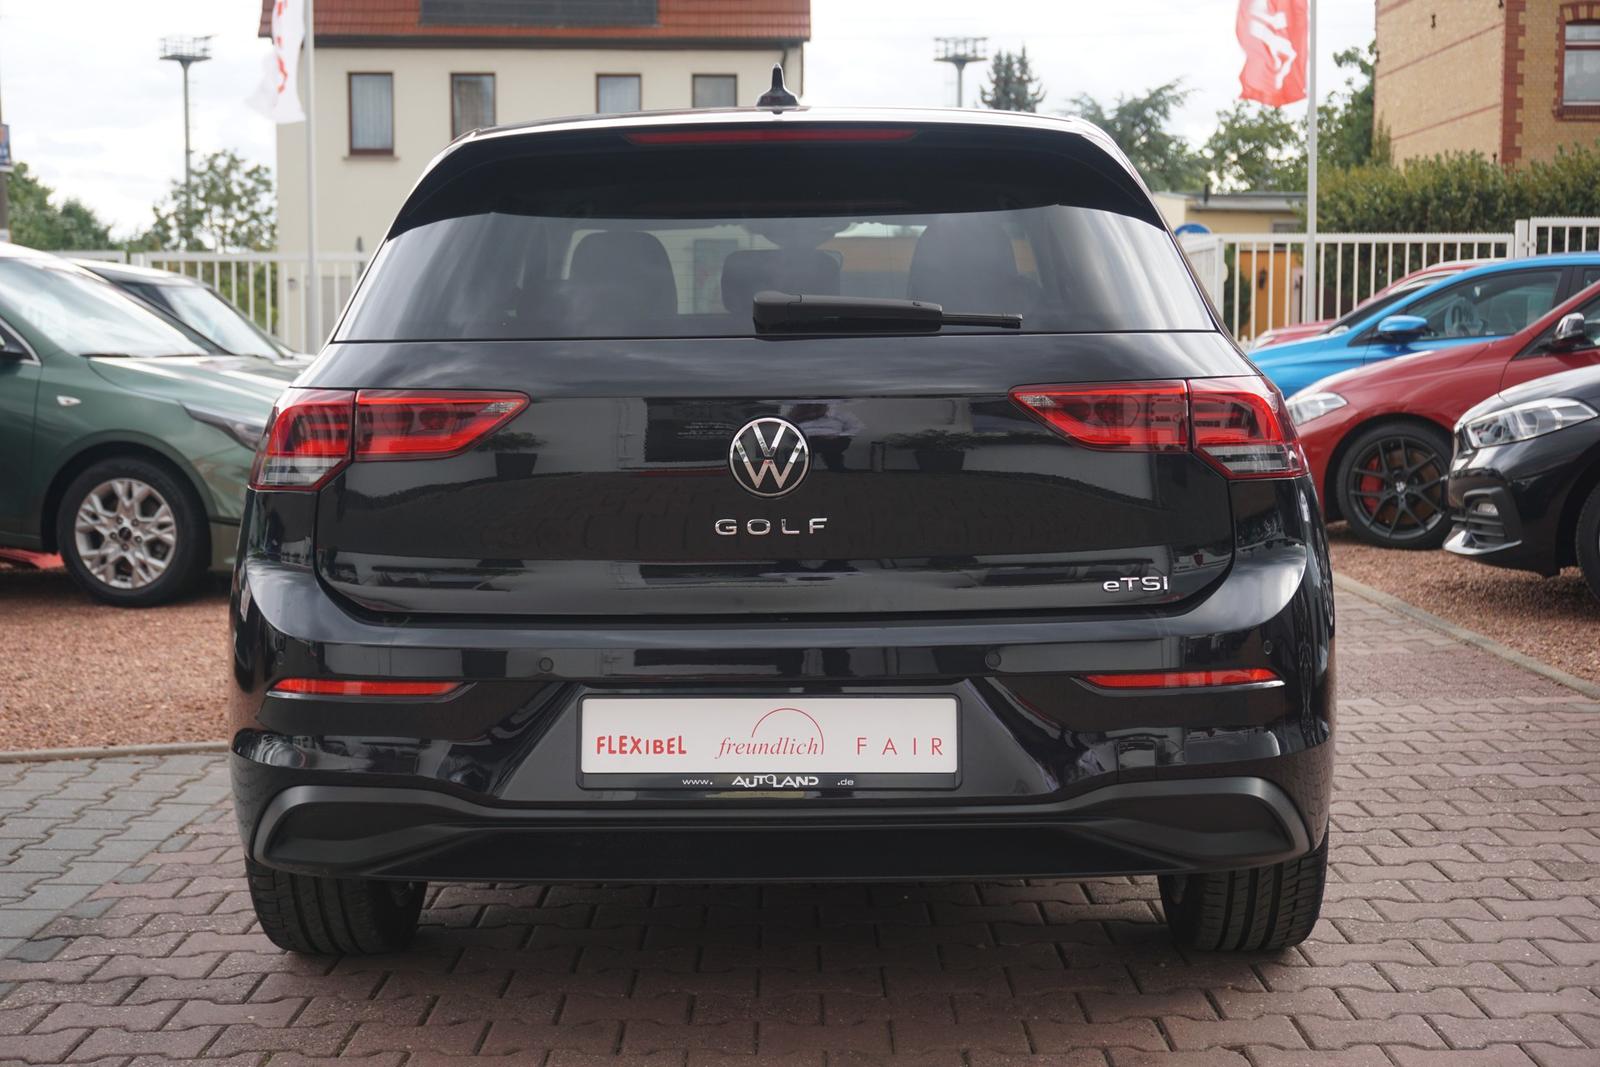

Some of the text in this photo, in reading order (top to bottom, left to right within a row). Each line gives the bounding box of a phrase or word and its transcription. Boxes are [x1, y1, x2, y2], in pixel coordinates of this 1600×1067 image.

[731, 419, 808, 495] VW
[714, 518, 828, 536] GOLF
[1103, 576, 1169, 592] eTSI
[596, 735, 944, 759] FLEXIBEL freundlich FAIR
[732, 774, 820, 789] AUTOLAND
[837, 778, 855, 786] .de
